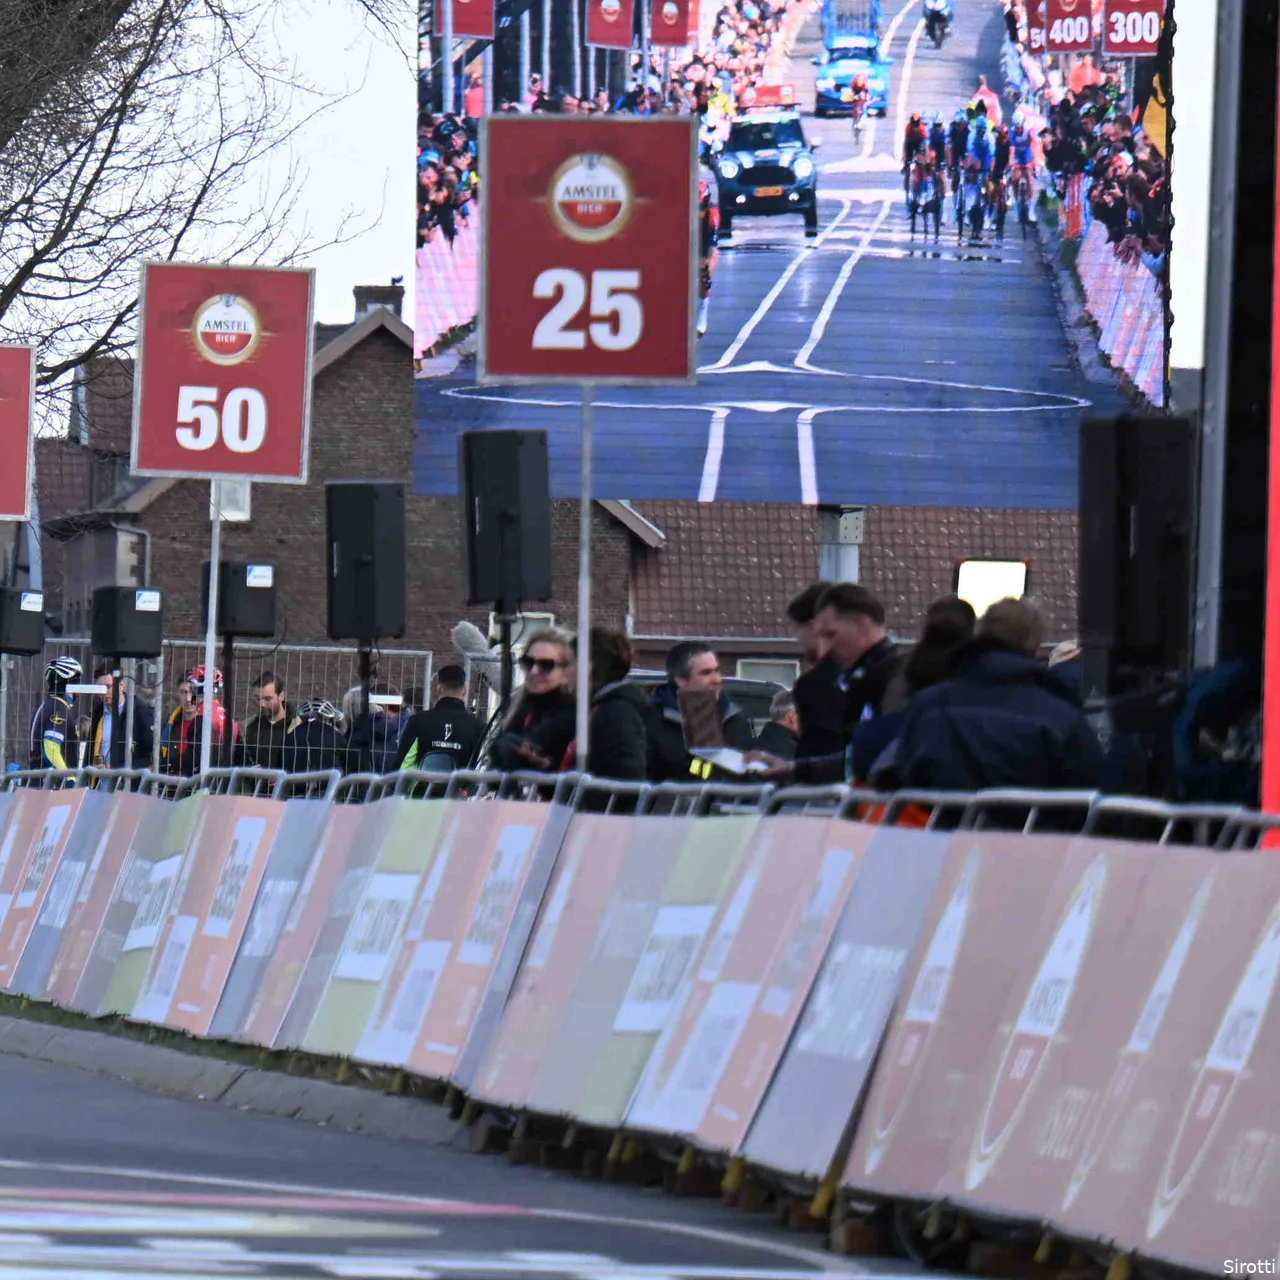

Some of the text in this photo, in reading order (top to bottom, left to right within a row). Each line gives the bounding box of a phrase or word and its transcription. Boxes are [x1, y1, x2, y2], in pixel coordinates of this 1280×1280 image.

[1049, 16, 1089, 44] 400
[1109, 11, 1160, 44] 300
[561, 184, 619, 200] AMSTEL
[531, 267, 644, 352] 25
[204, 319, 250, 332] AMSTEL
[215, 333, 238, 343] BIER
[175, 384, 267, 454] 50
